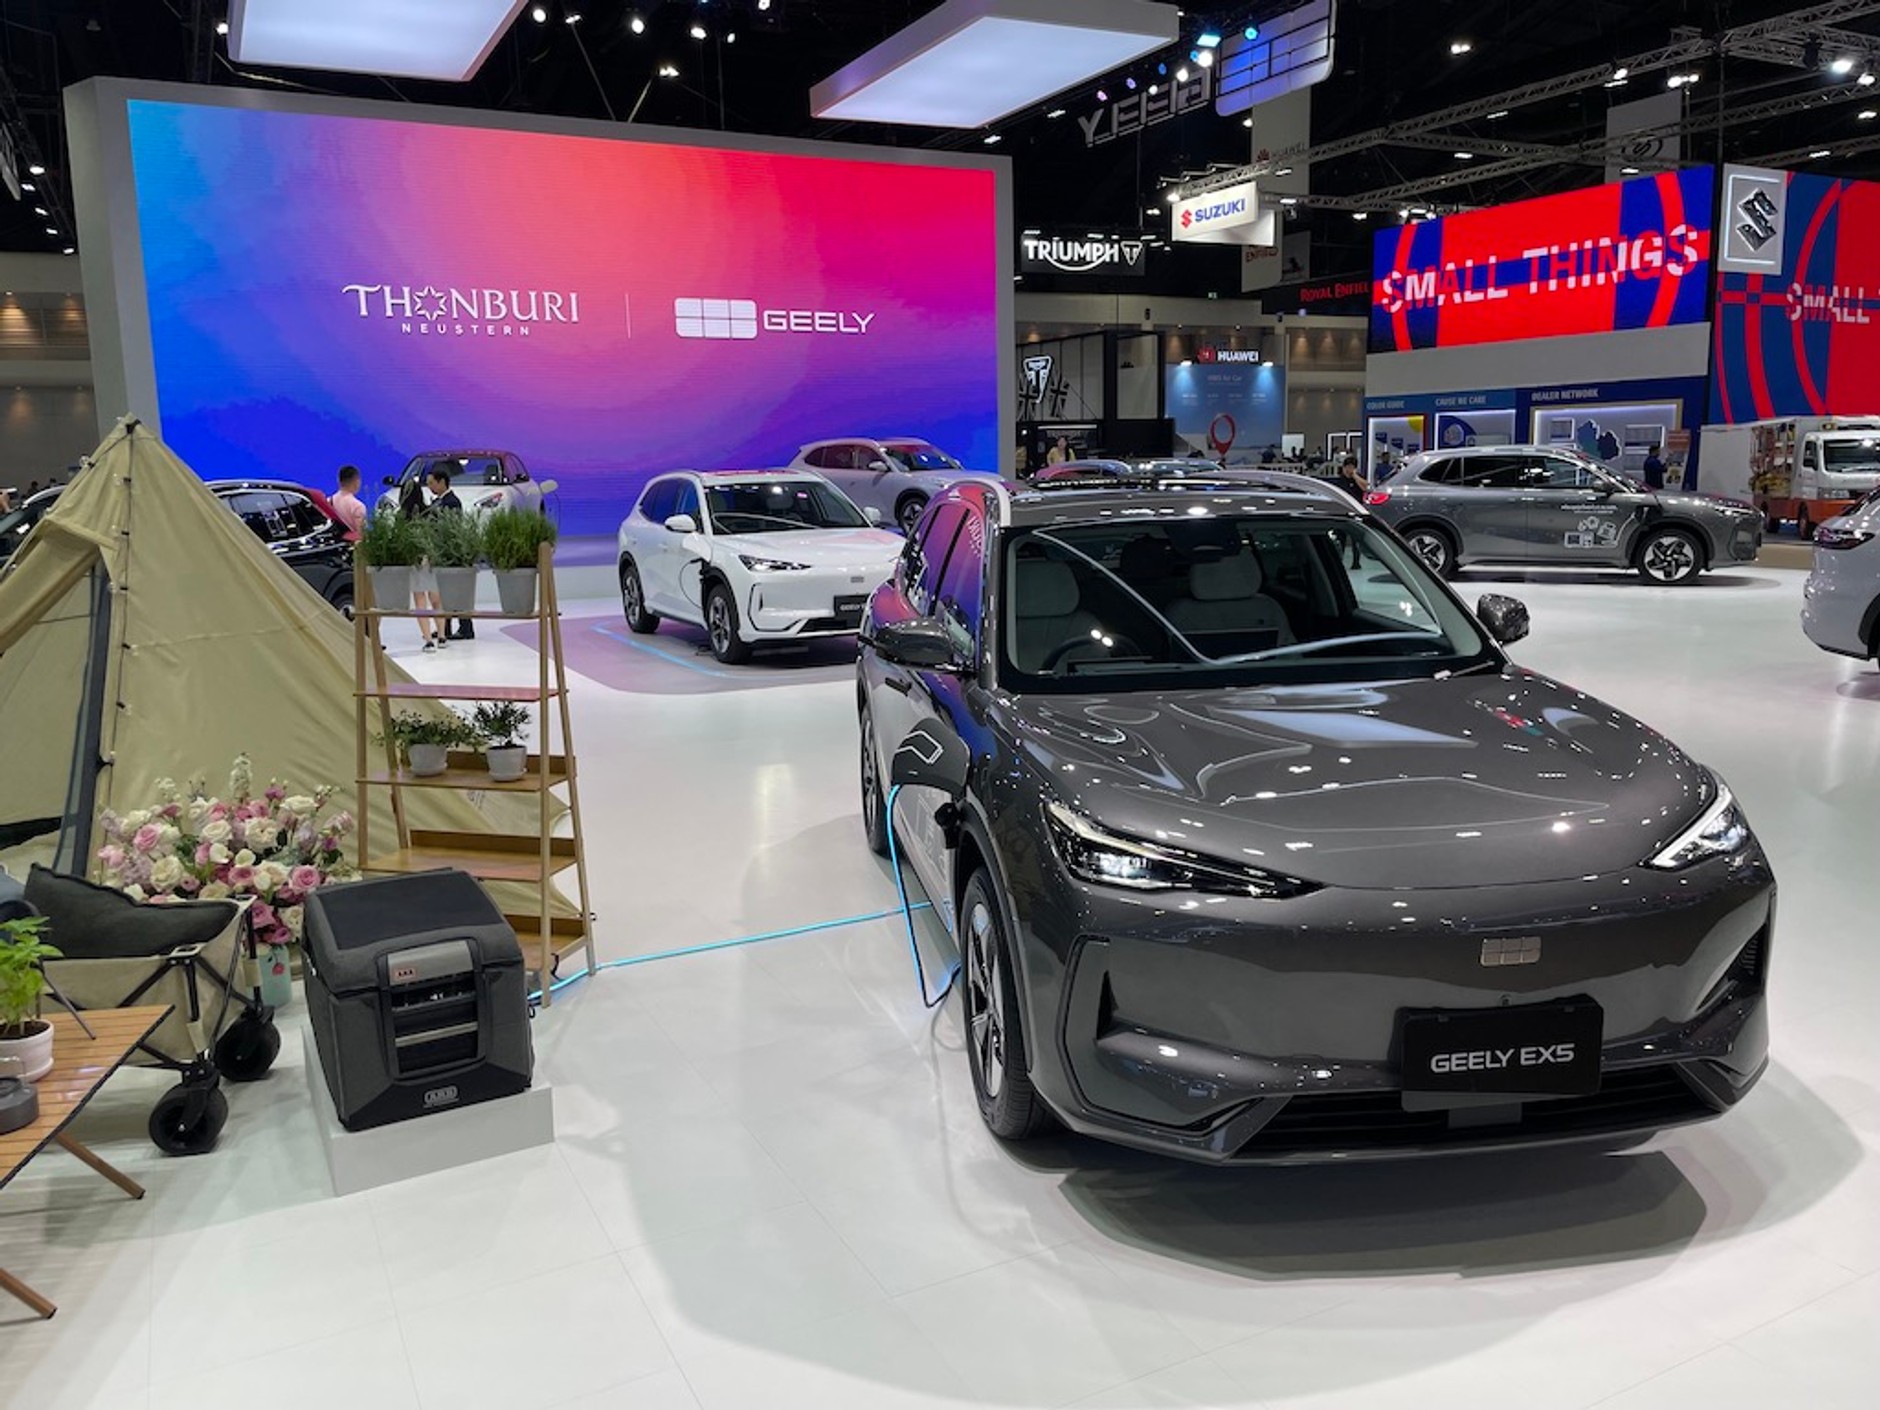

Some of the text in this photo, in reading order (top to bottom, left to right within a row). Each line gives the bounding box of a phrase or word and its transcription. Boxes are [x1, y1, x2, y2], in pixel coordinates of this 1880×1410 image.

[1194, 198, 1246, 223] SUZUKI
[1024, 237, 1119, 271] TRIUMPH
[1380, 224, 1699, 314] SMALL THINGS
[342, 284, 579, 323] THONBURI
[1300, 282, 1370, 302] ROYAL ENFIEL
[1786, 282, 1870, 324] SMALL
[401, 322, 531, 337] NEUSTERN
[763, 309, 875, 334] GEELY
[1217, 351, 1259, 362] HUAWEI
[1531, 388, 1599, 402] DEALER NETWORK
[1430, 1043, 1576, 1073] GEELY EX5
